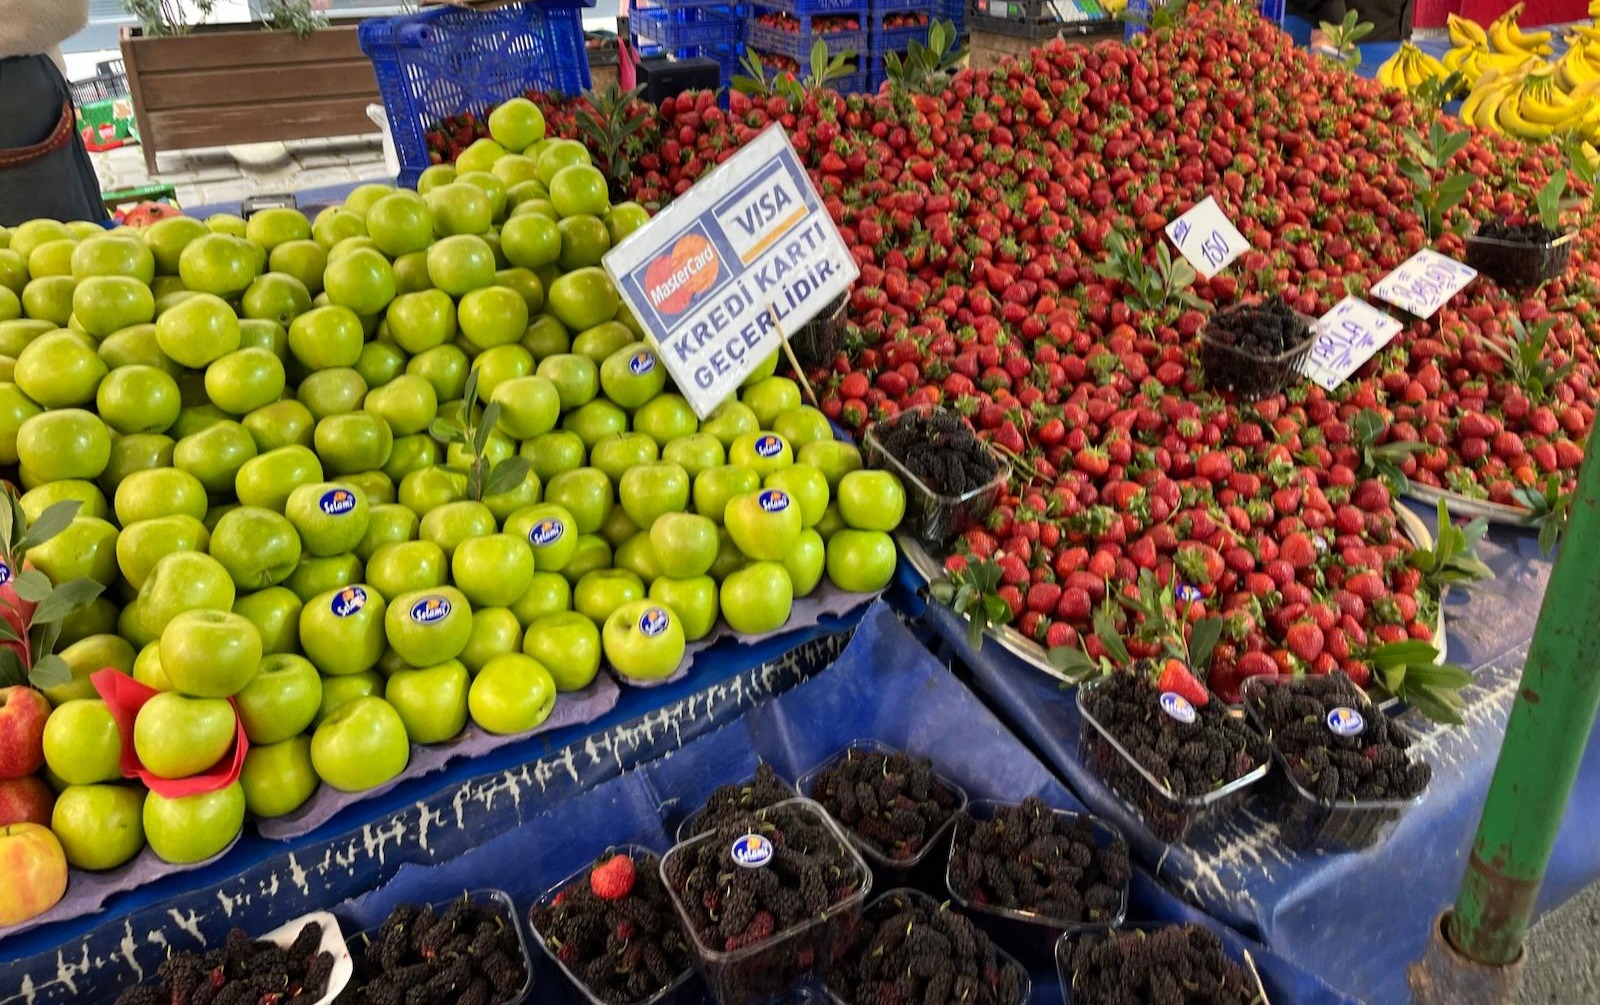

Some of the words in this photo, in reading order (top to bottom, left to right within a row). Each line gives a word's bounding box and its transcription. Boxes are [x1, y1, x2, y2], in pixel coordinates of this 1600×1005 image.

[734, 184, 792, 236] VISA
[649, 243, 714, 307] MasterCard
[1201, 230, 1229, 268] 150
[673, 280, 754, 363] KREDİ
[754, 222, 826, 293] KARTI
